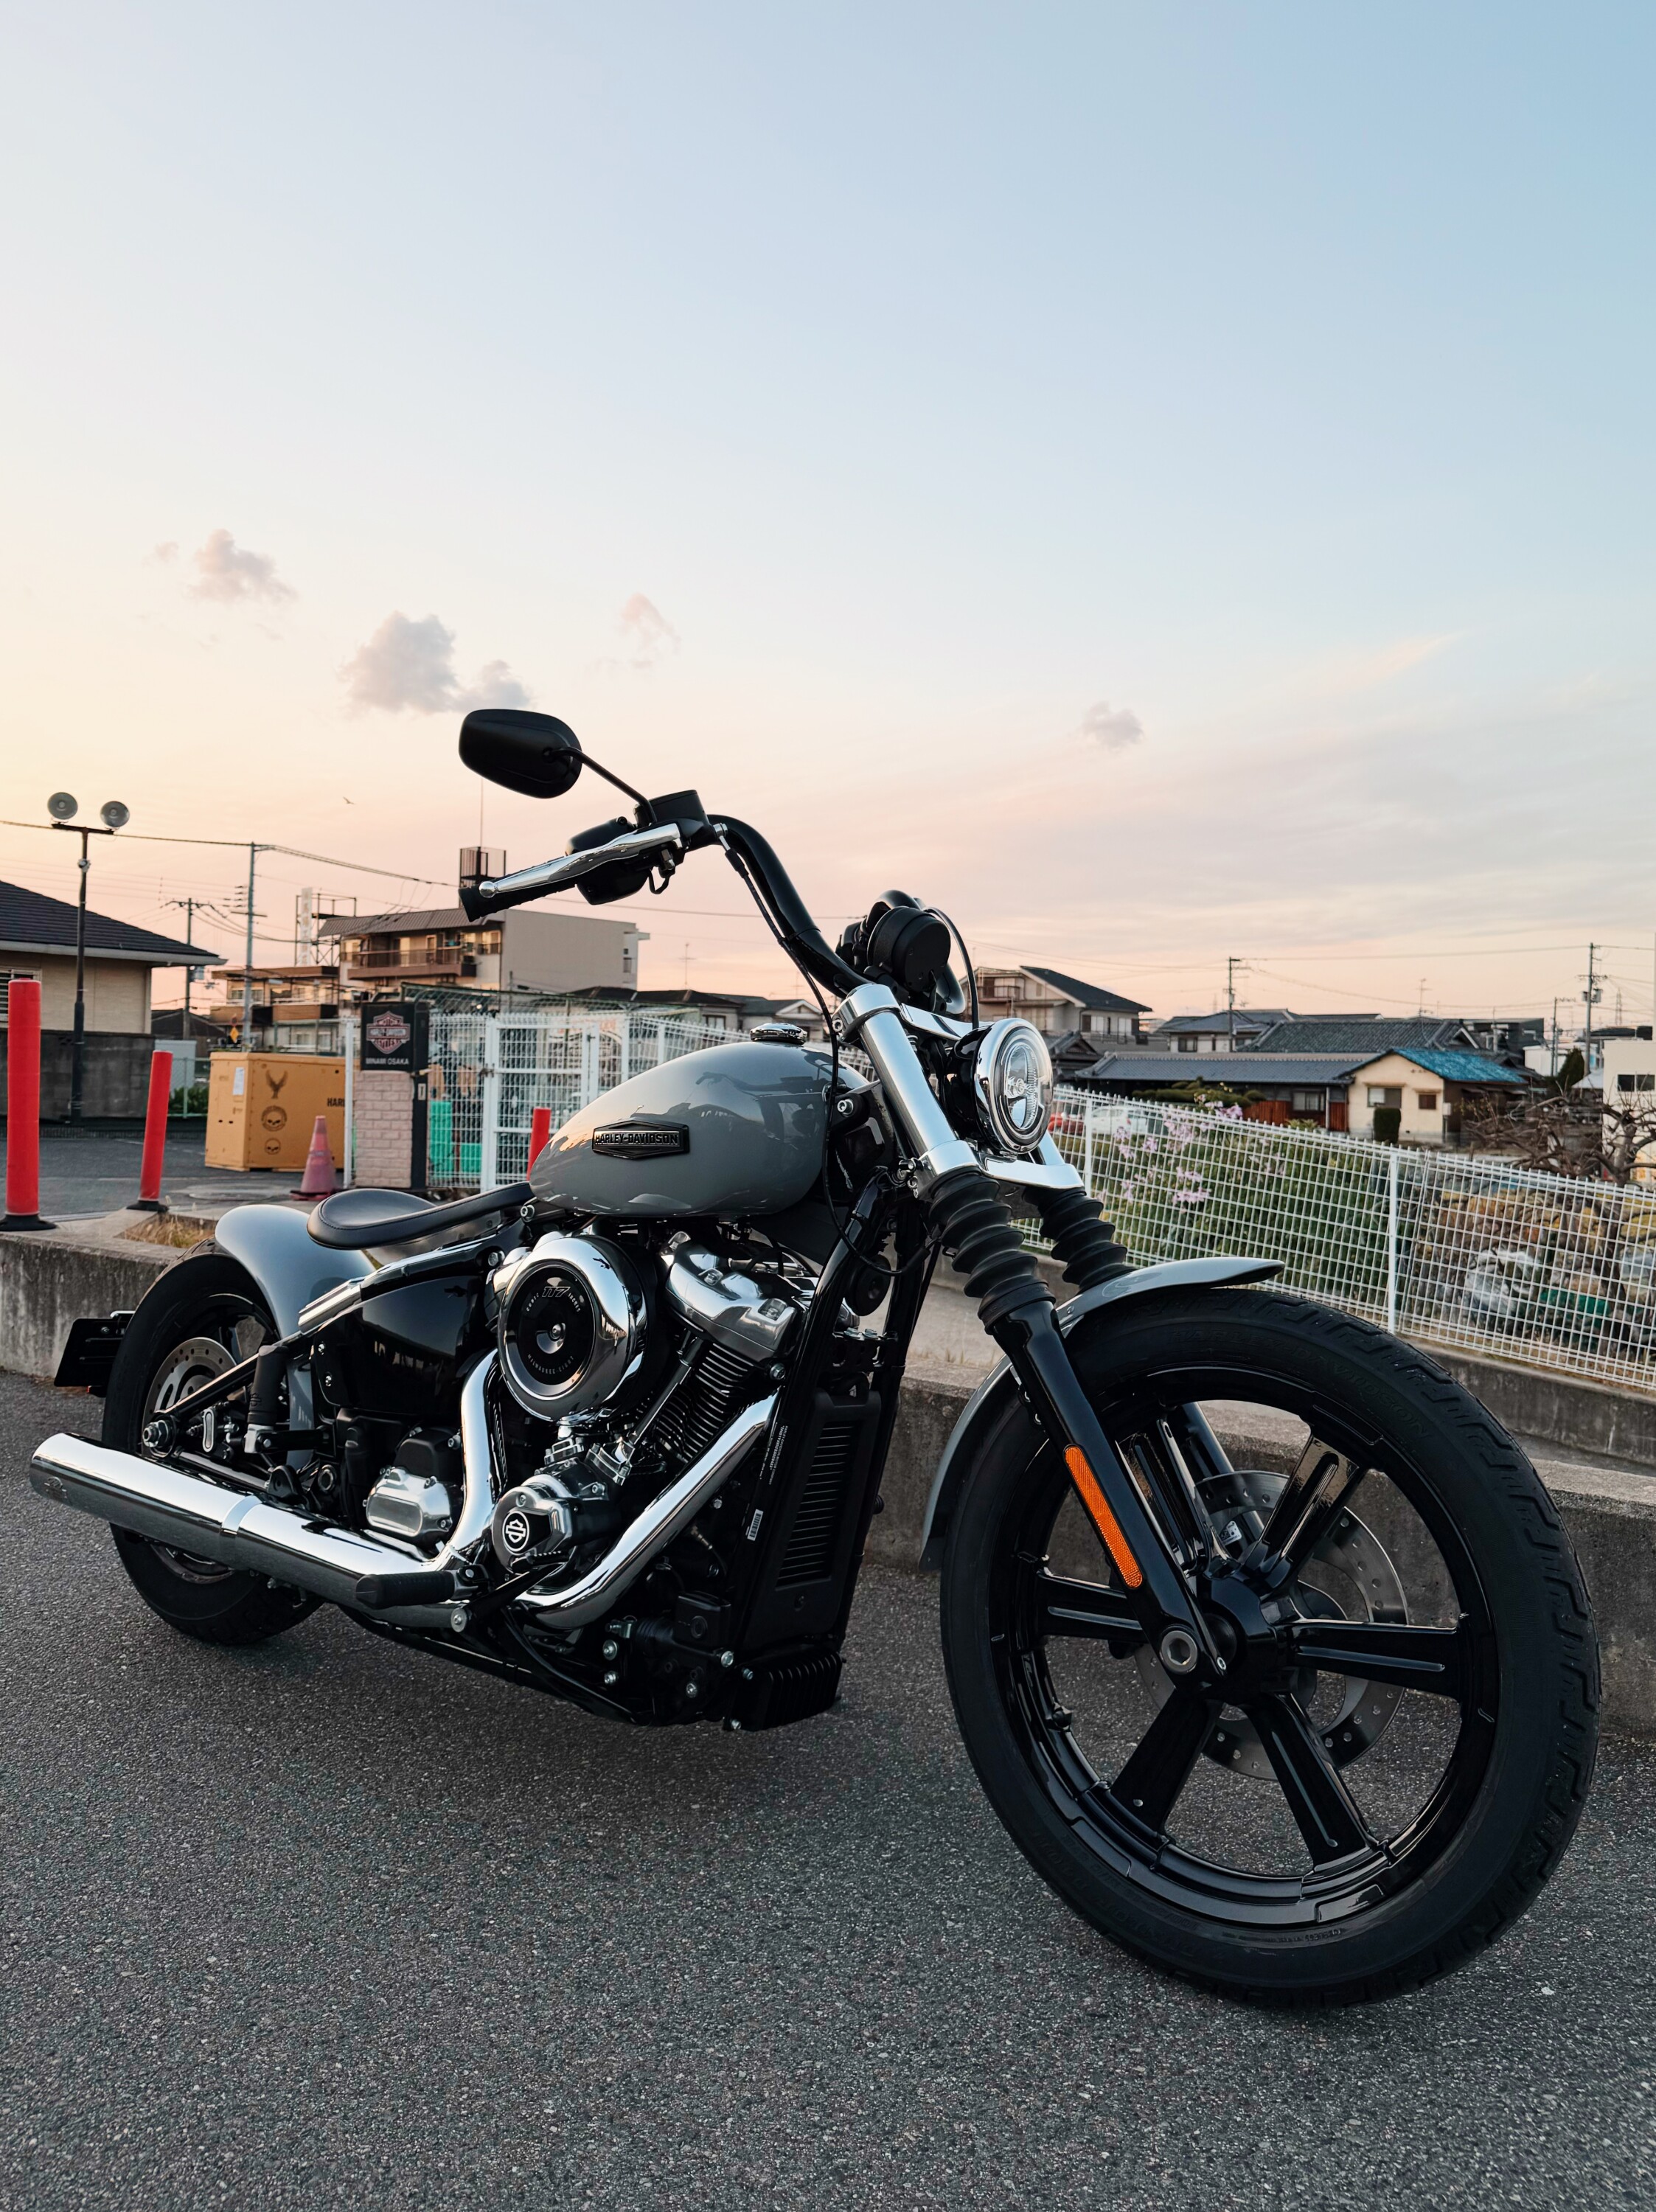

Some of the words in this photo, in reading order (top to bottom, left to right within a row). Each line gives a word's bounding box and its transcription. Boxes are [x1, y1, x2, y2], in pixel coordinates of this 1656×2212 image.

[595, 1133, 678, 1144] HARLEY-DAVIDSON
[526, 1293, 540, 1312] CUBIC
[542, 1286, 571, 1298] 117
[568, 1293, 581, 1312] INCHES
[527, 1354, 574, 1374] MILWAUKEE-EIGHT
[1167, 1329, 1433, 1439] HARLEY-DAVIDSON
